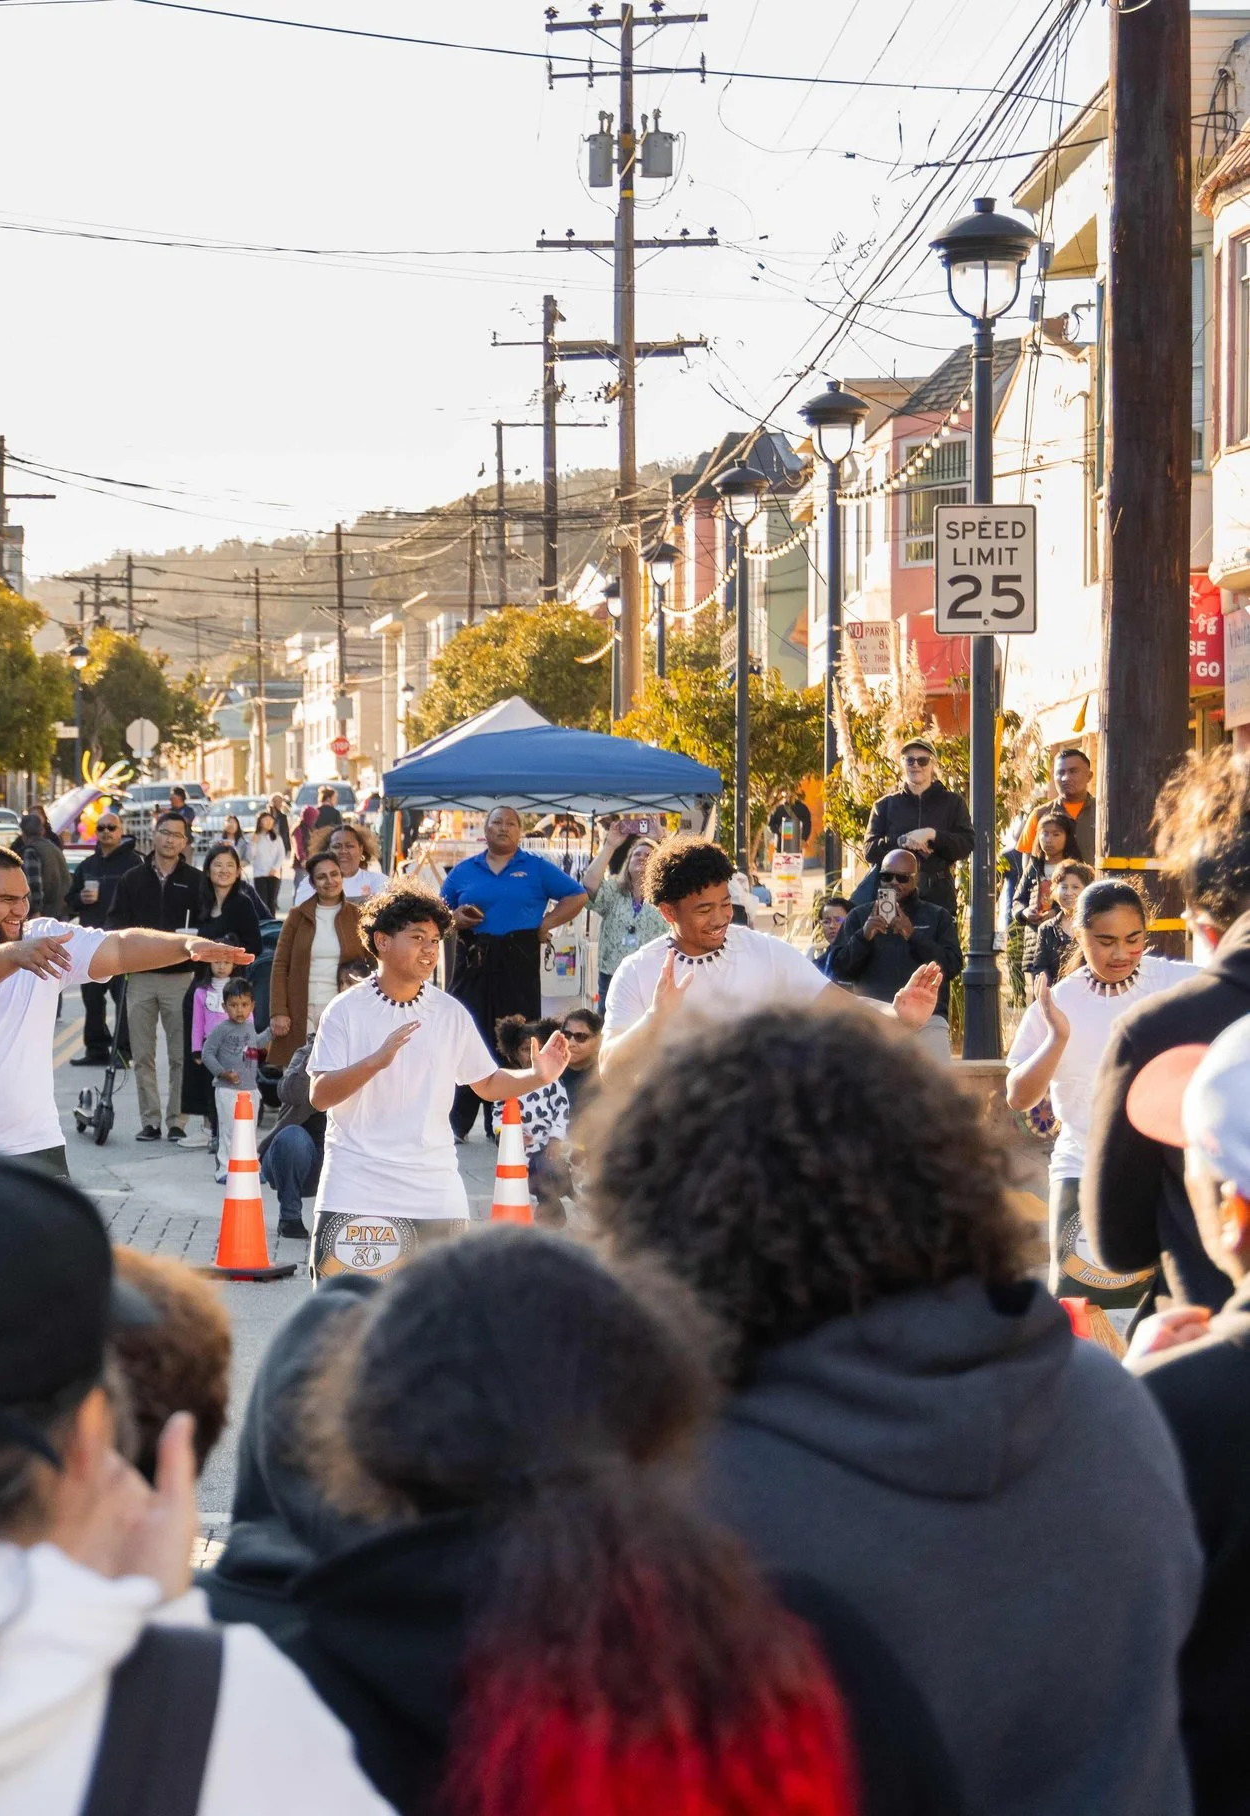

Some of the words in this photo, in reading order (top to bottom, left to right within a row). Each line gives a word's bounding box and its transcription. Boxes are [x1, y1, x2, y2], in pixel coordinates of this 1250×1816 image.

[946, 521, 1026, 539] SPEED
[953, 547, 1018, 566] LIMIT
[947, 574, 1025, 619] 25
[848, 623, 862, 637] NO
[1196, 661, 1221, 677] GO
[346, 1225, 397, 1242] PIYA
[1079, 1266, 1137, 1286] Anniversary
